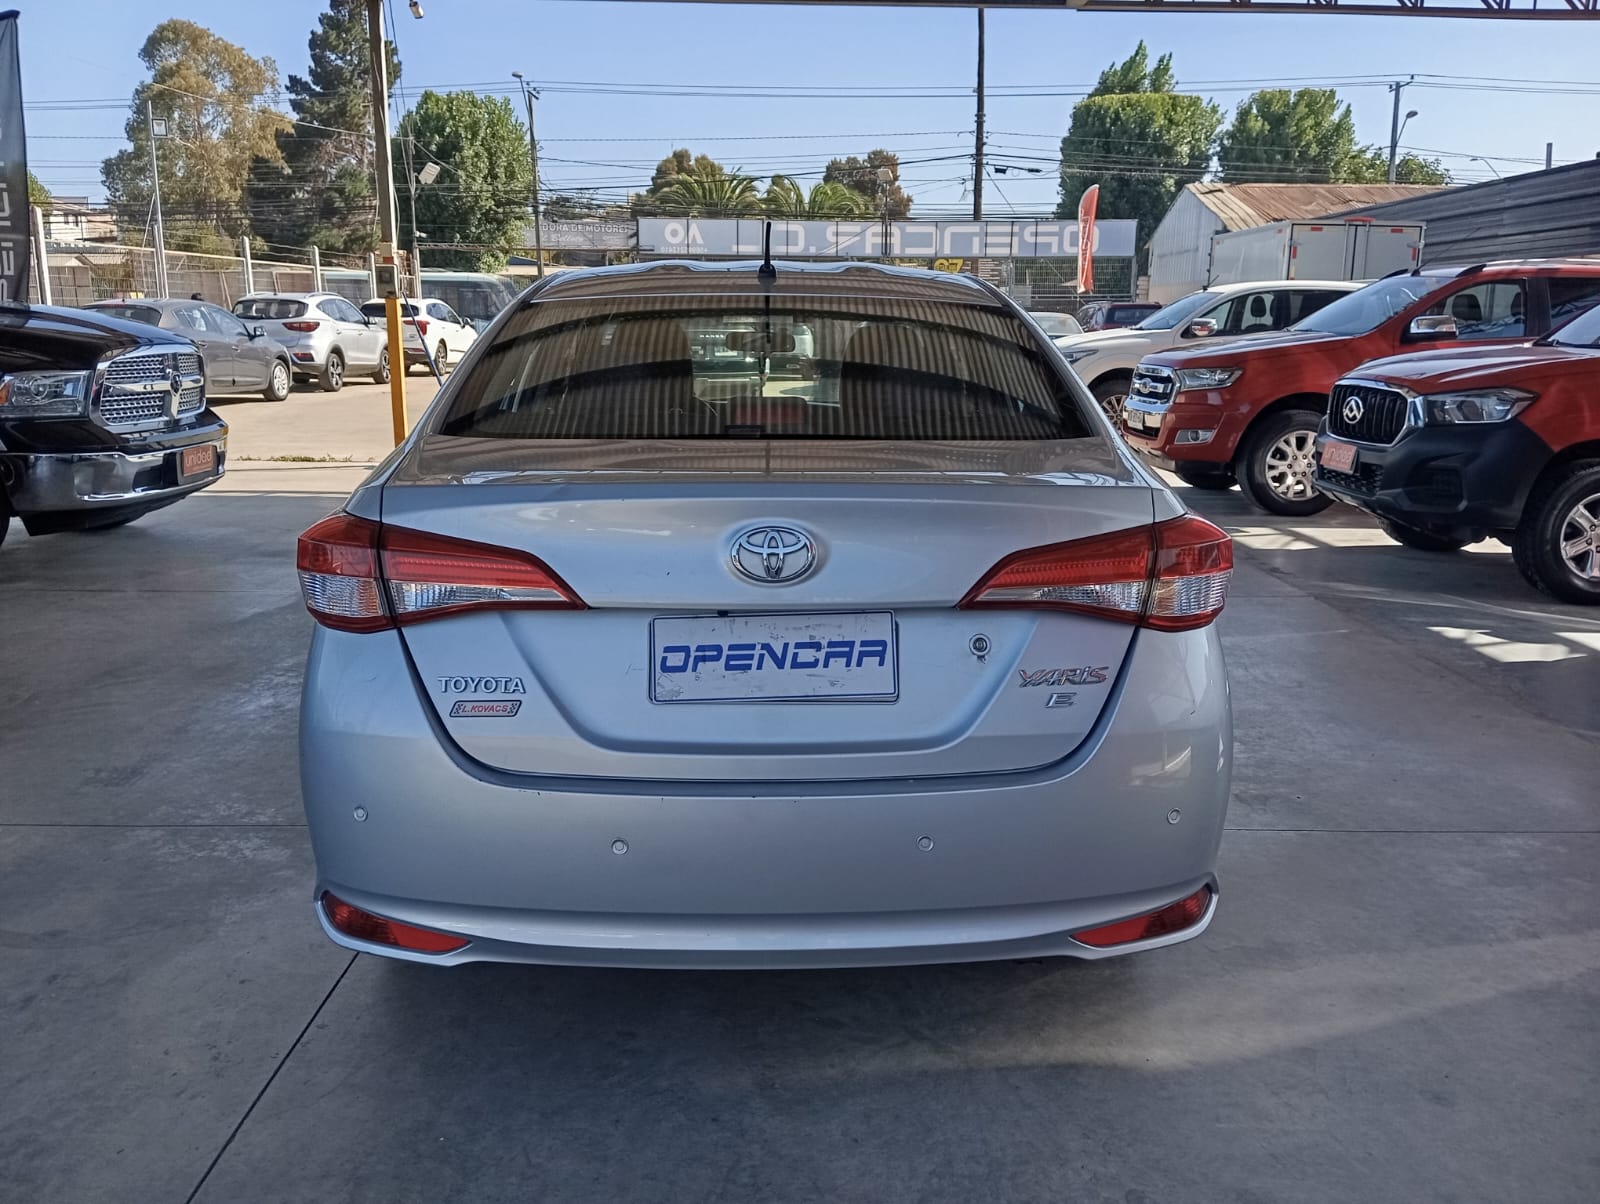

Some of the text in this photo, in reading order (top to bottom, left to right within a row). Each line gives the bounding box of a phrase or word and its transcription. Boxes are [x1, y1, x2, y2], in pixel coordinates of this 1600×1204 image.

[660, 639, 888, 673] OPENCAR
[437, 676, 526, 694] TOYOTA
[1045, 692, 1077, 708] E
